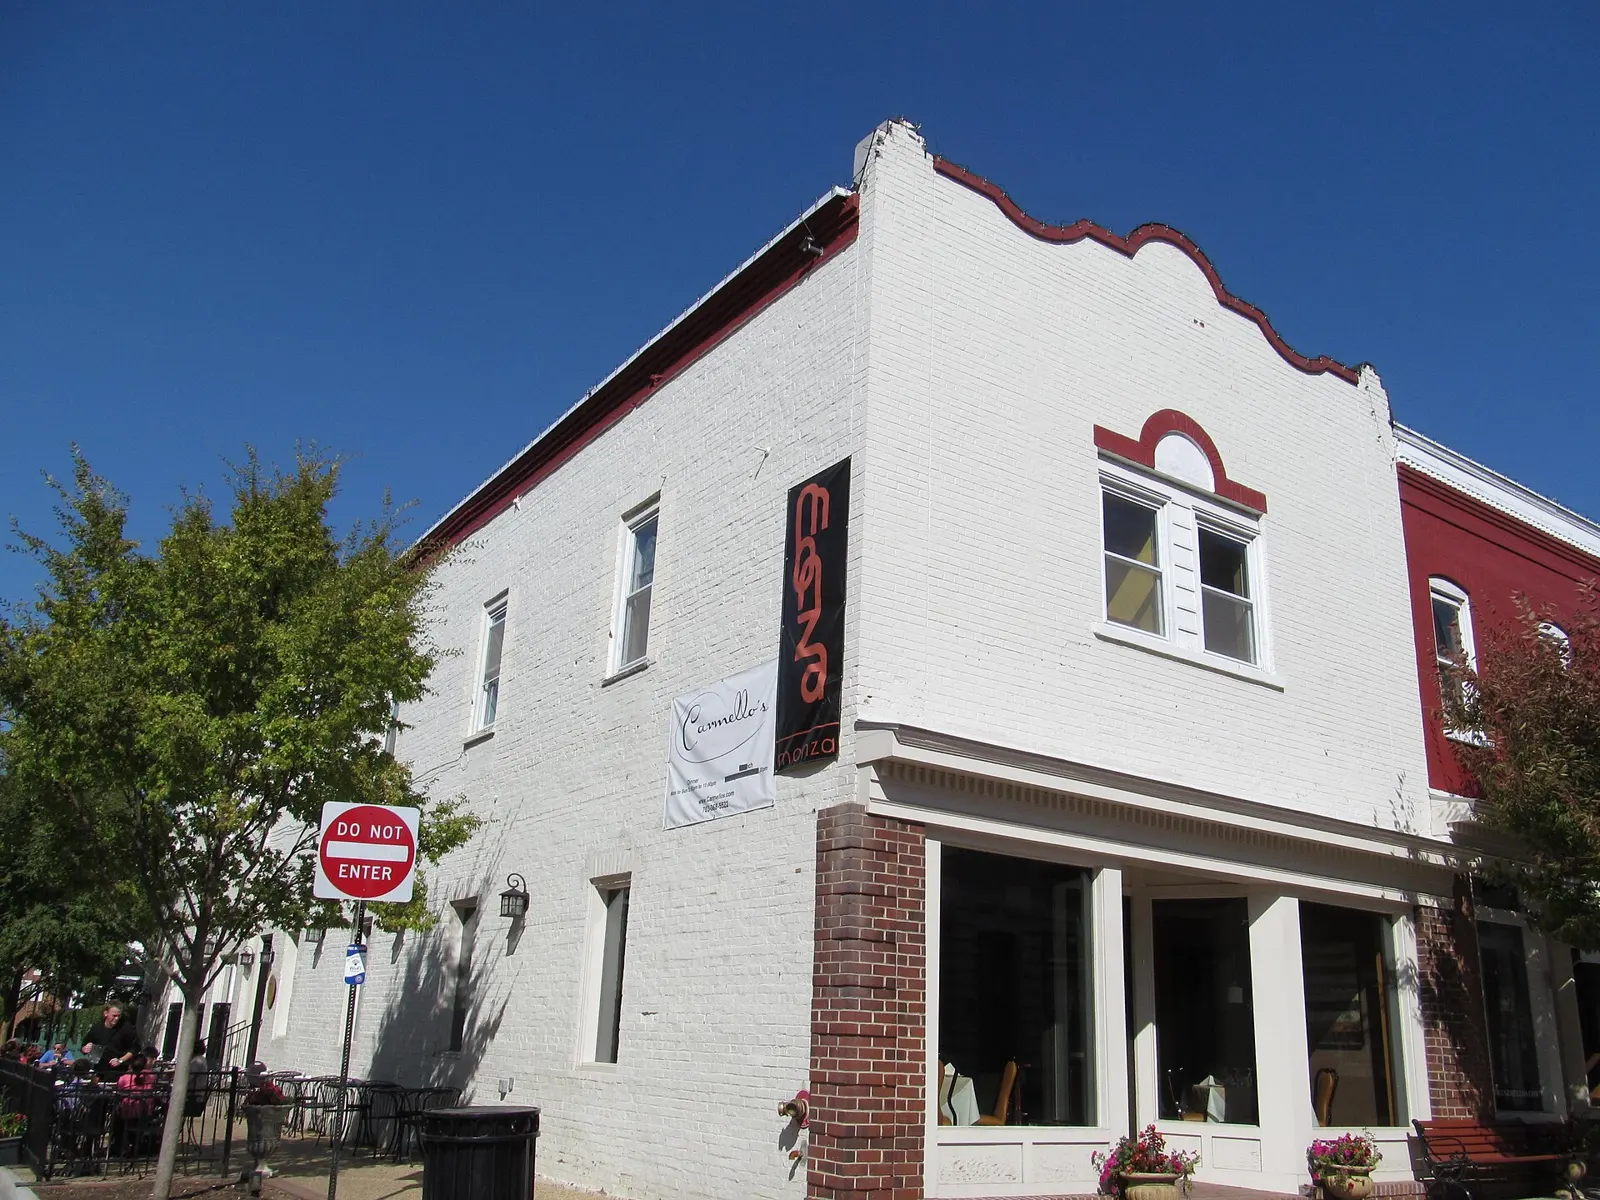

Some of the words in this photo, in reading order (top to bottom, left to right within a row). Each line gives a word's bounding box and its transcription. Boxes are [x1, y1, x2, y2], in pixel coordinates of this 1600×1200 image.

[682, 688, 770, 752] Carmello's
[777, 737, 835, 768] monza
[337, 821, 361, 837] DO
[370, 824, 403, 840] NOT
[338, 863, 392, 881] ENTER
